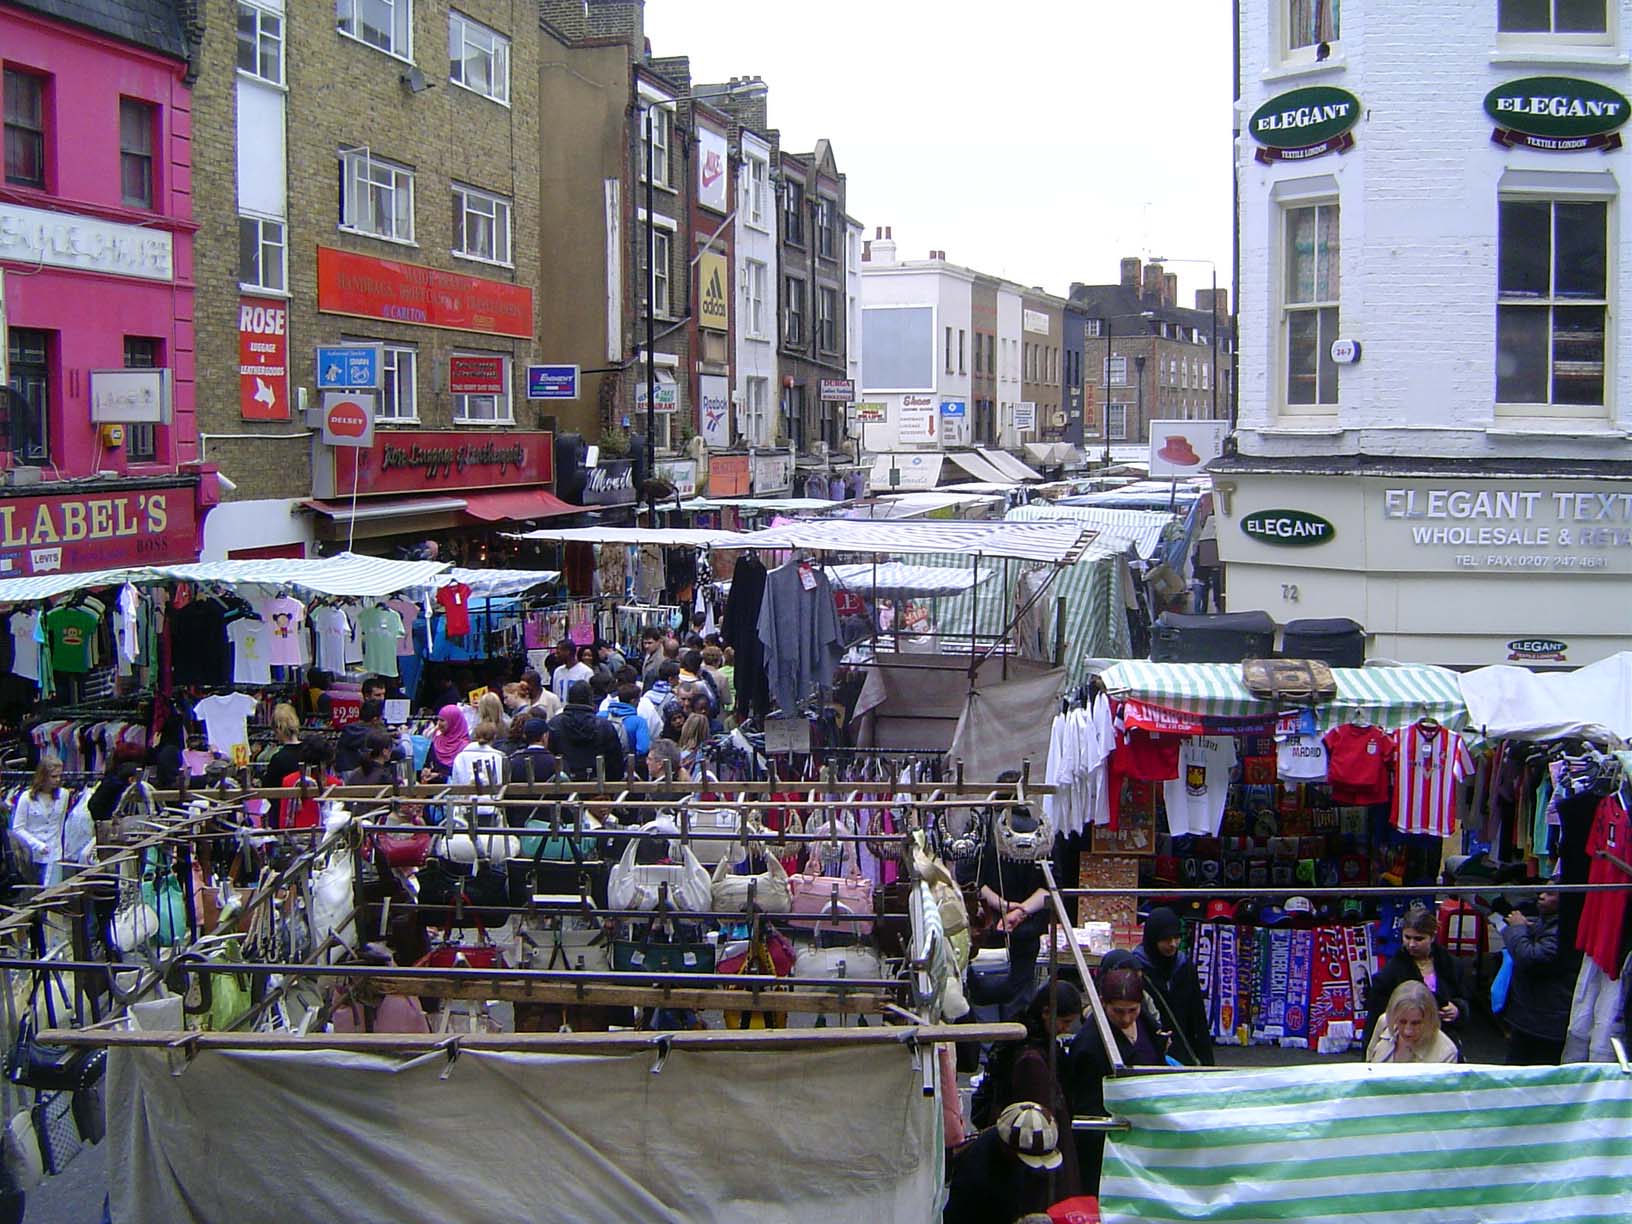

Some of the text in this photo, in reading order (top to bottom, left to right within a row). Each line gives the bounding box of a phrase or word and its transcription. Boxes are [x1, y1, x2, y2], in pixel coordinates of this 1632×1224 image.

[1500, 96, 1619, 117] ELEGANT
[1258, 104, 1349, 130] ELEGANT
[1527, 137, 1588, 149] TEXTILE LONDON
[702, 299, 727, 318] adidas
[241, 306, 285, 335] ROSE
[703, 395, 727, 410] Reebok
[331, 416, 363, 425] DELSEY
[1384, 489, 1540, 519] ELEGANT
[0, 495, 167, 547] LABEL'S
[1247, 518, 1325, 537] ELEGANT
[1412, 527, 1549, 545] WHOLESALE
[1558, 528, 1573, 546] &
[1281, 584, 1299, 601] 72
[1513, 641, 1563, 652] ELEGANT
[333, 706, 360, 723] £2.99
